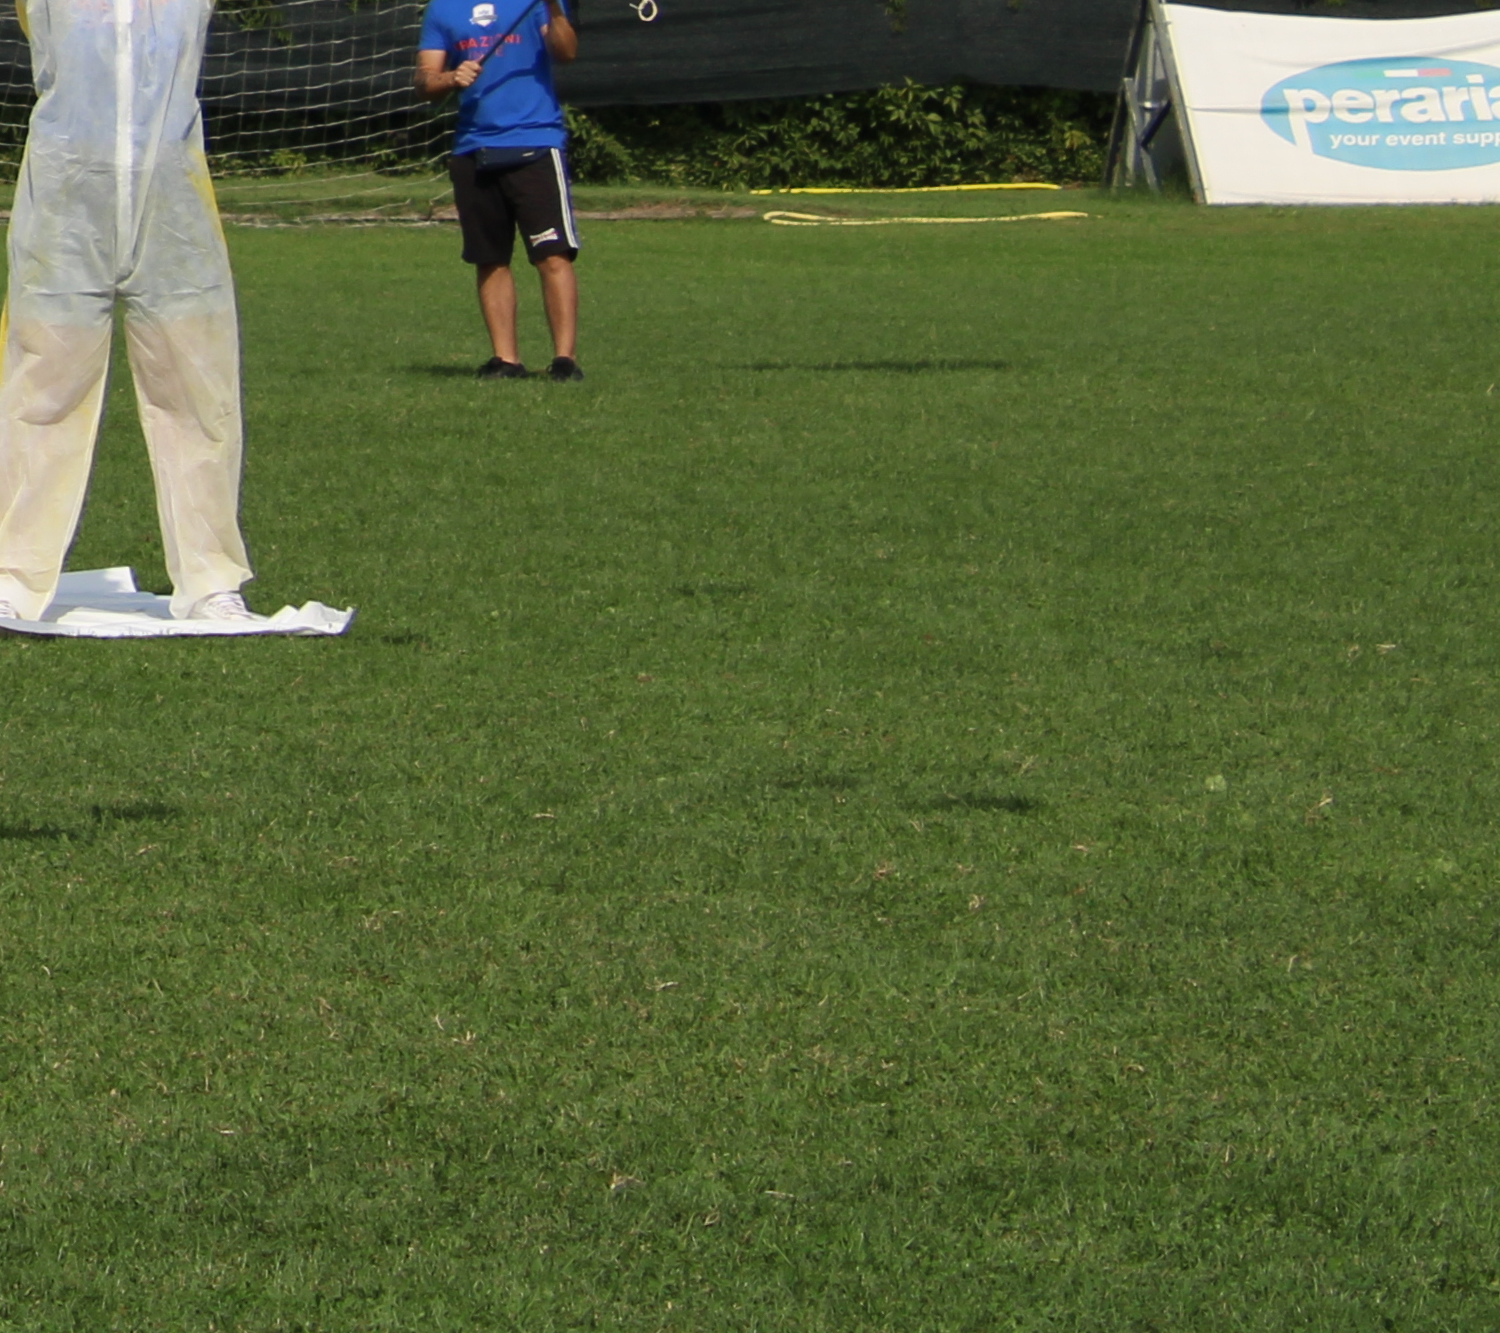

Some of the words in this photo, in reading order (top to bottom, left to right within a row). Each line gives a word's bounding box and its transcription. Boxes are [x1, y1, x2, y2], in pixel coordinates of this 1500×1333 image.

[1283, 74, 1500, 156] perari
[1330, 133, 1380, 149] your
[1385, 131, 1446, 146] event
